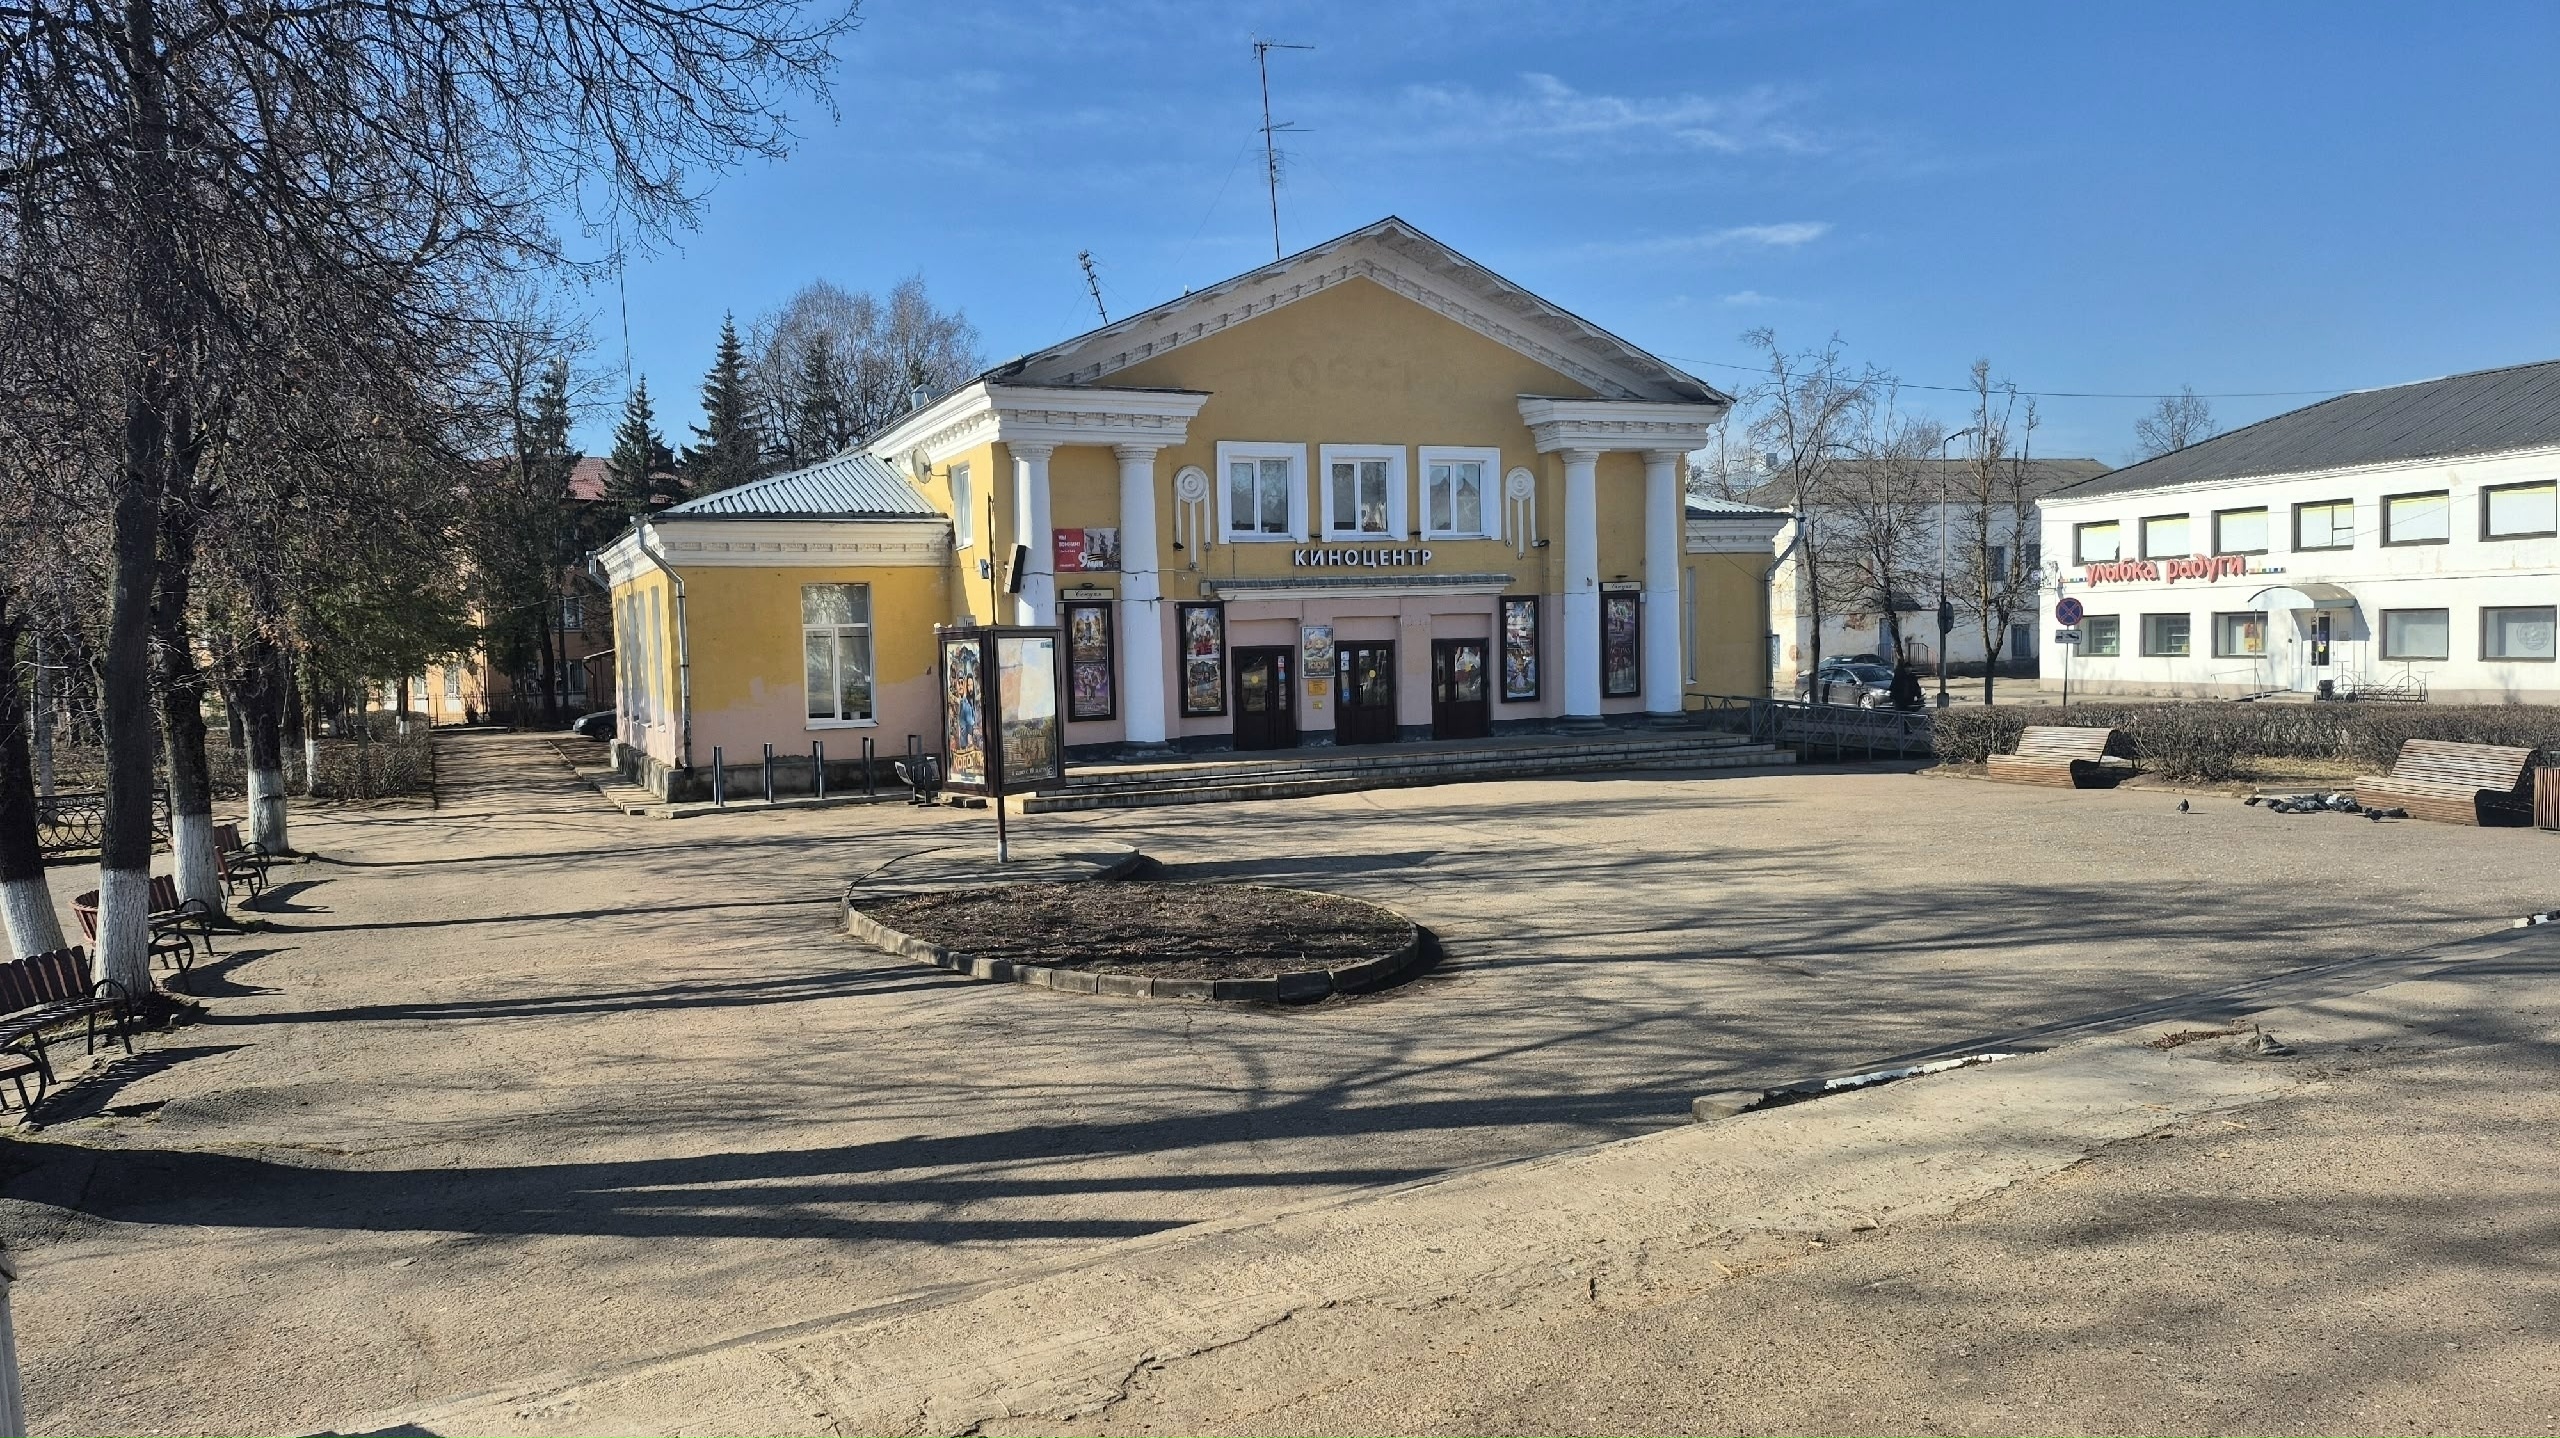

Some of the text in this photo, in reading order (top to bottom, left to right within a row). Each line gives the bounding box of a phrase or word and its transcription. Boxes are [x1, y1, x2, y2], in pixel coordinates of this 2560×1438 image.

[1078, 552, 1087, 568] 9
[1295, 549, 1432, 568] КИНОЦЕНТР
[2085, 553, 2247, 588] улыбка радуги
